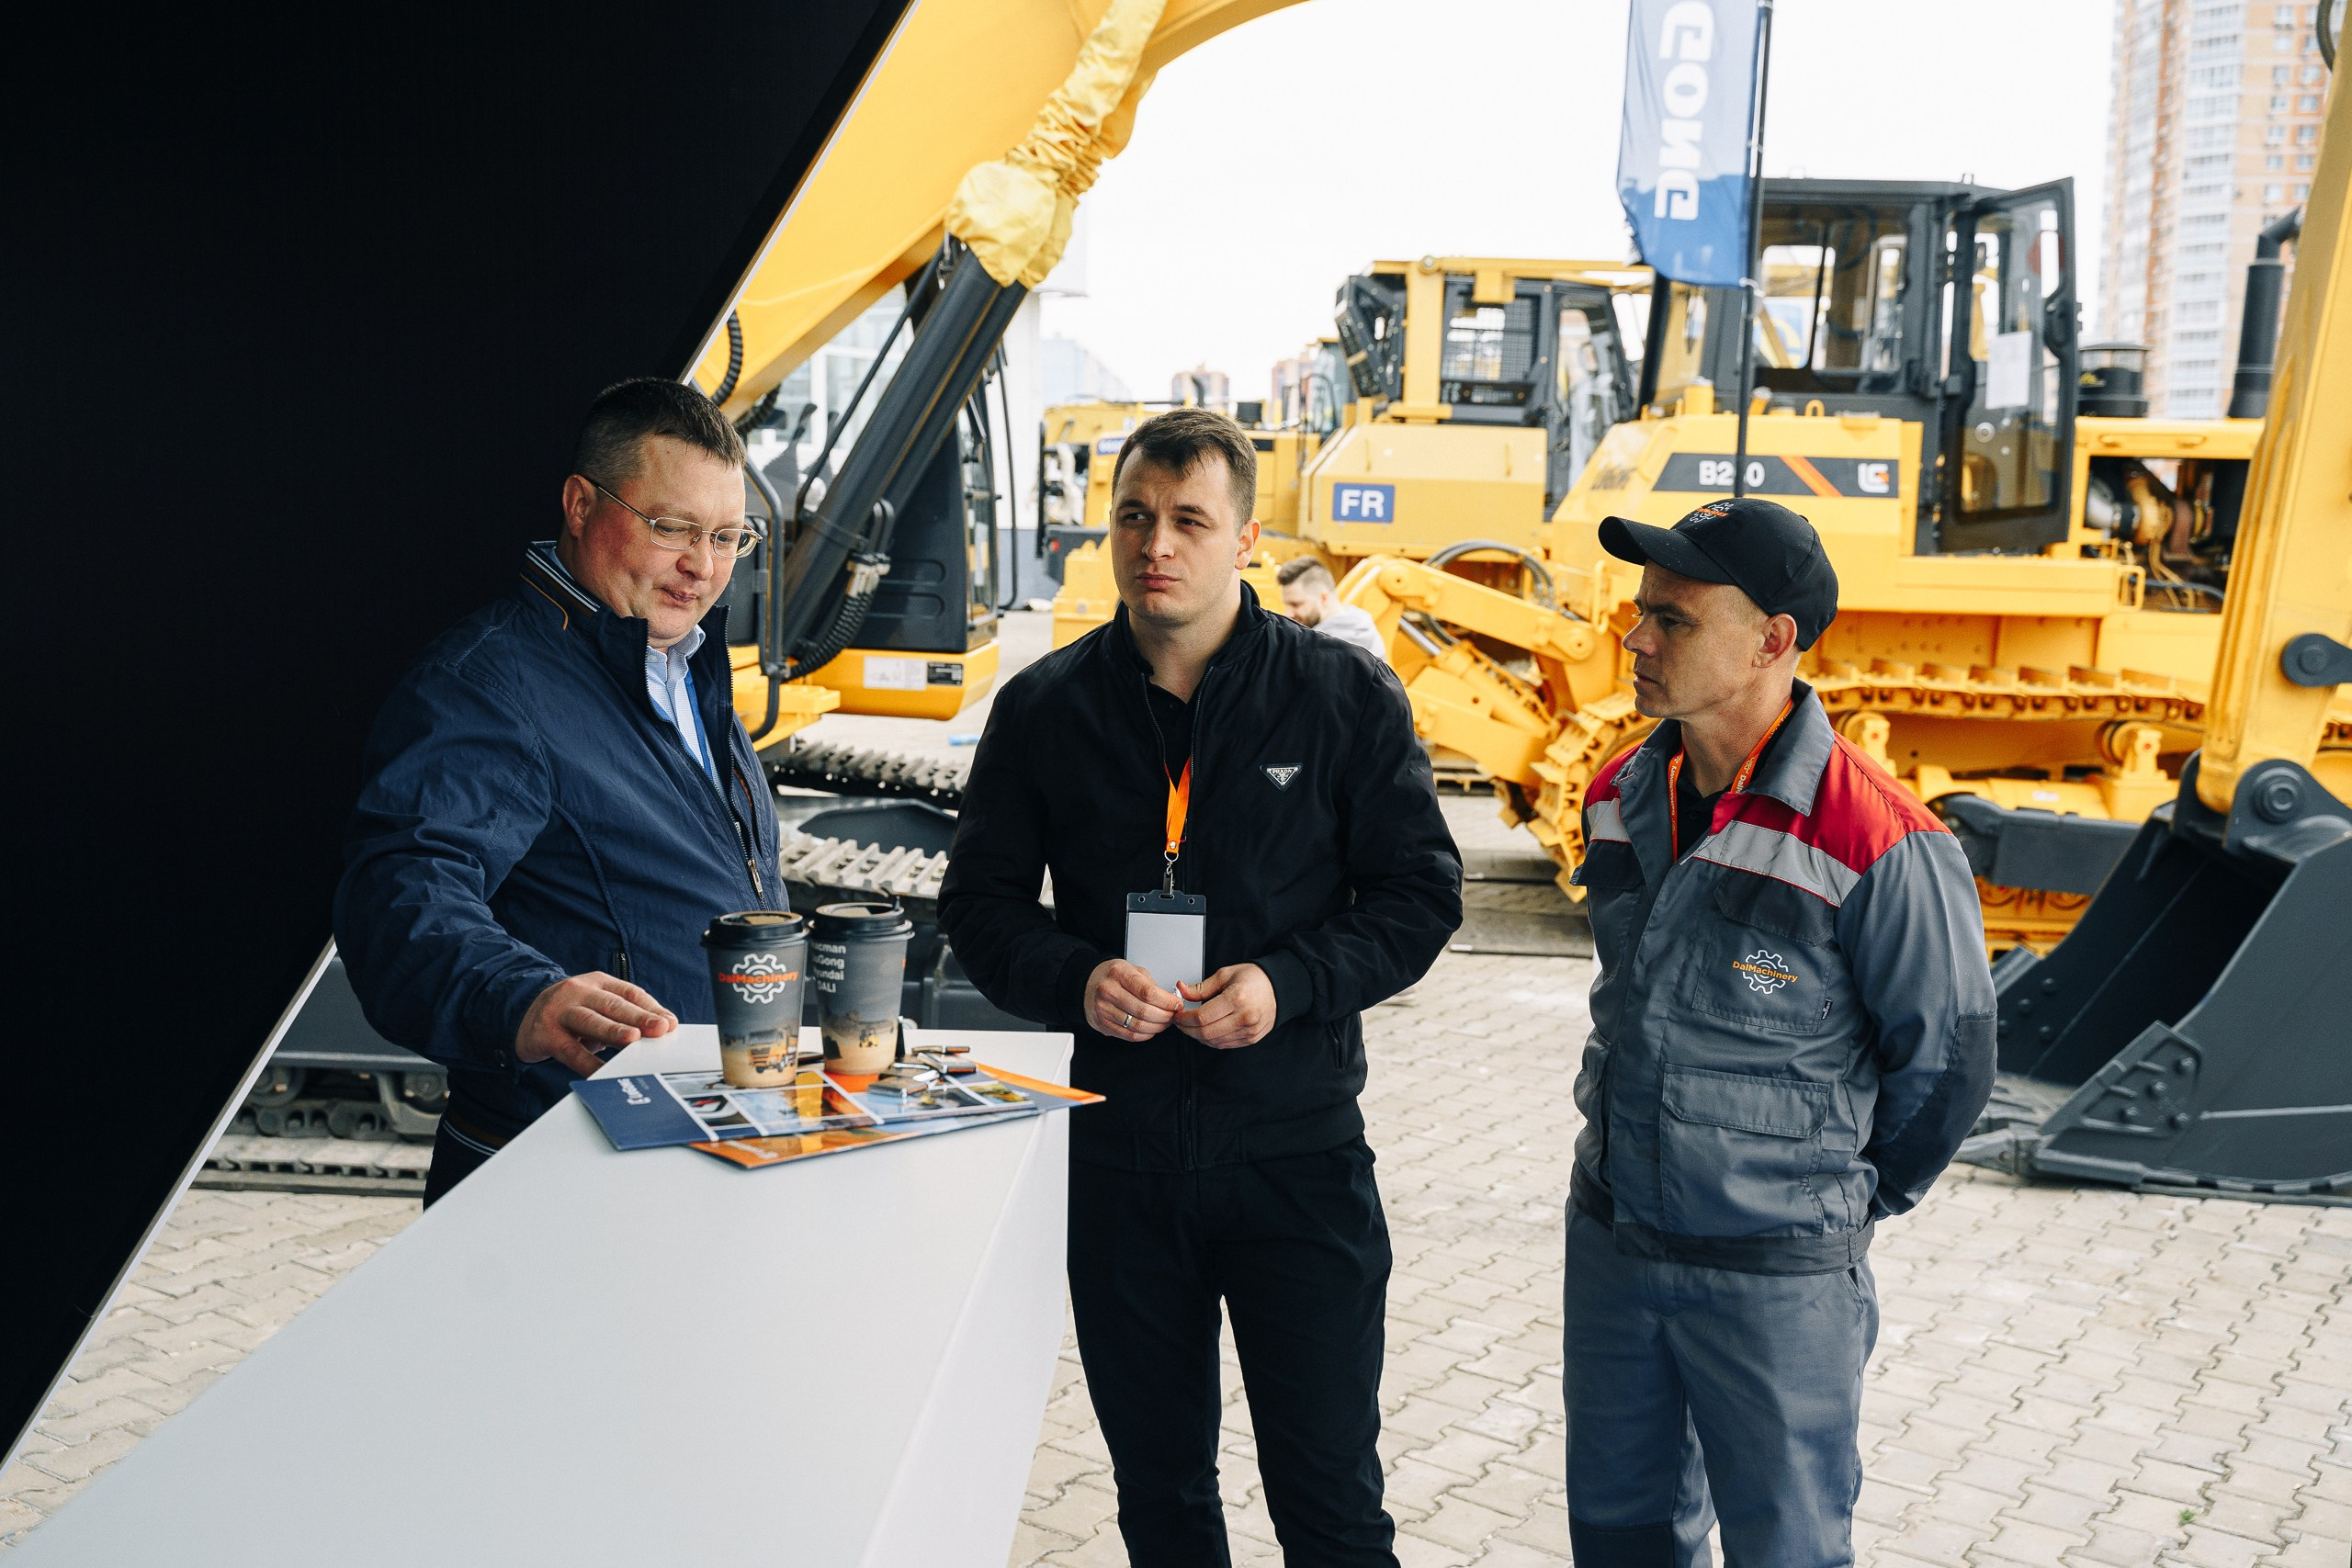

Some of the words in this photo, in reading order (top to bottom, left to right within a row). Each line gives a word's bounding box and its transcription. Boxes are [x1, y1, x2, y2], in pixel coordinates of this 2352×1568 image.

[1699, 460, 1765, 488] B20
[1340, 489, 1385, 518] FR
[1732, 961, 1798, 983] DalMachinery
